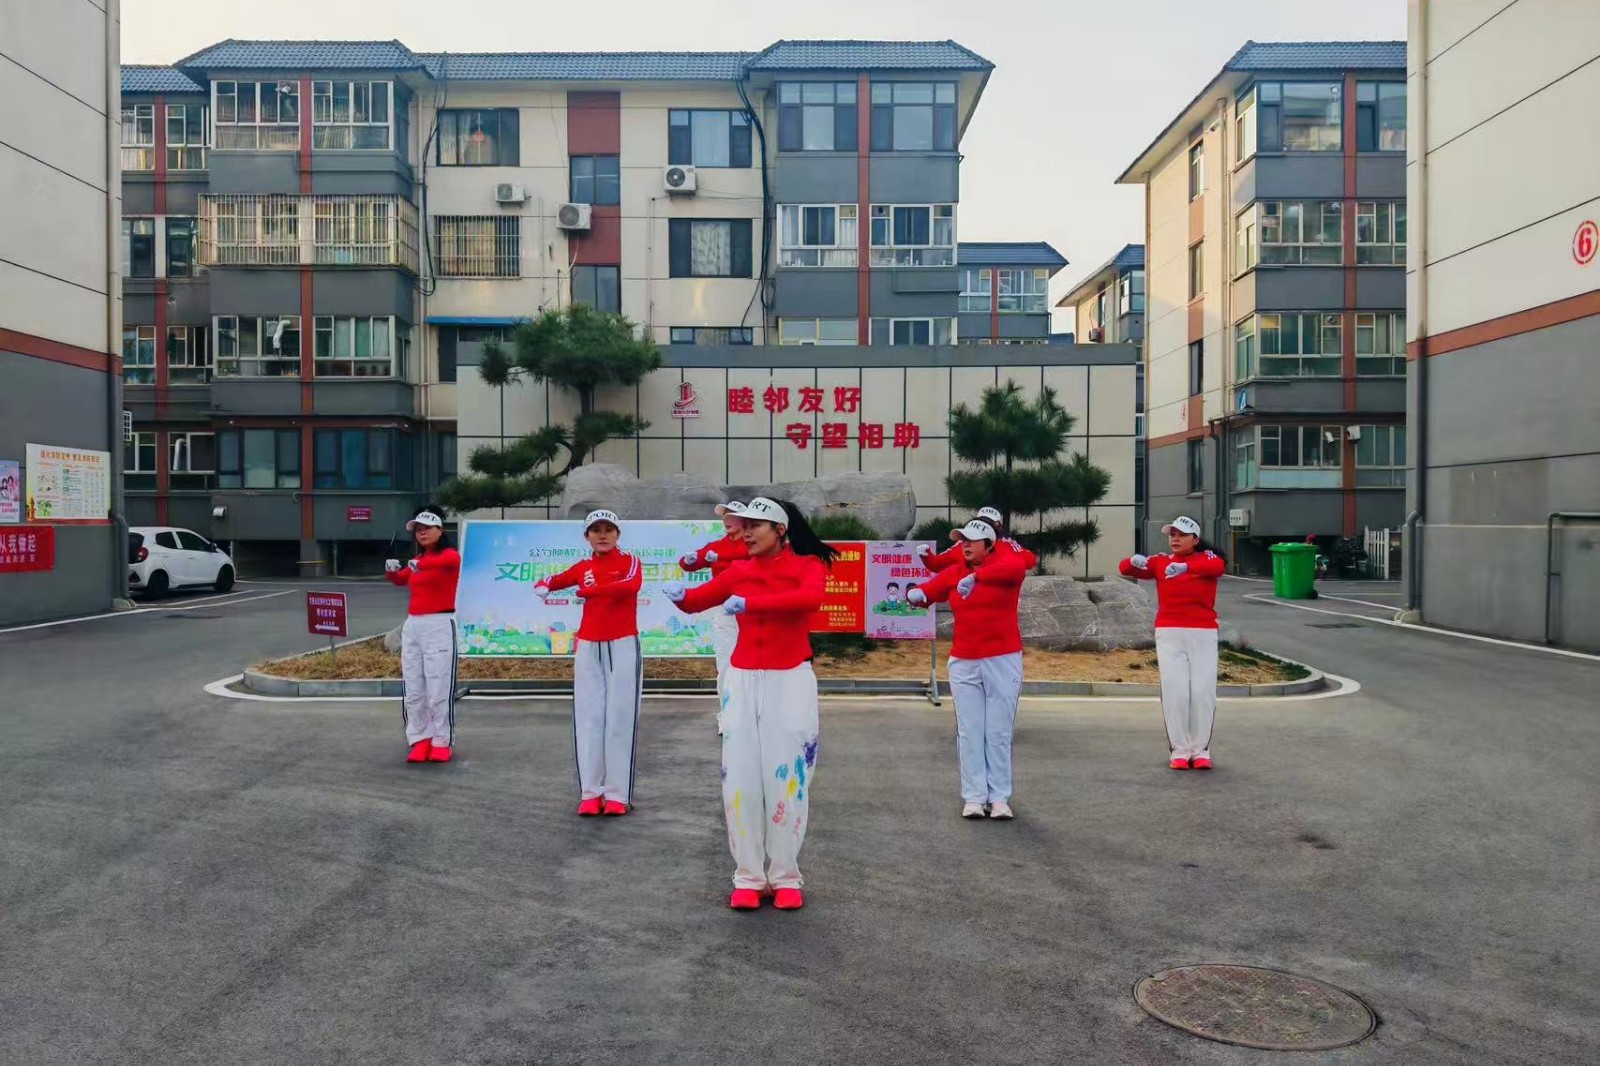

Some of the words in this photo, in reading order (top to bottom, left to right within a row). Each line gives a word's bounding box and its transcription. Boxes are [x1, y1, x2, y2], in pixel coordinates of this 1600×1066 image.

[1579, 228, 1592, 258] 6
[728, 386, 861, 414] 睦邻友好
[786, 422, 920, 449] 守望相助
[871, 554, 913, 564] 文明健康
